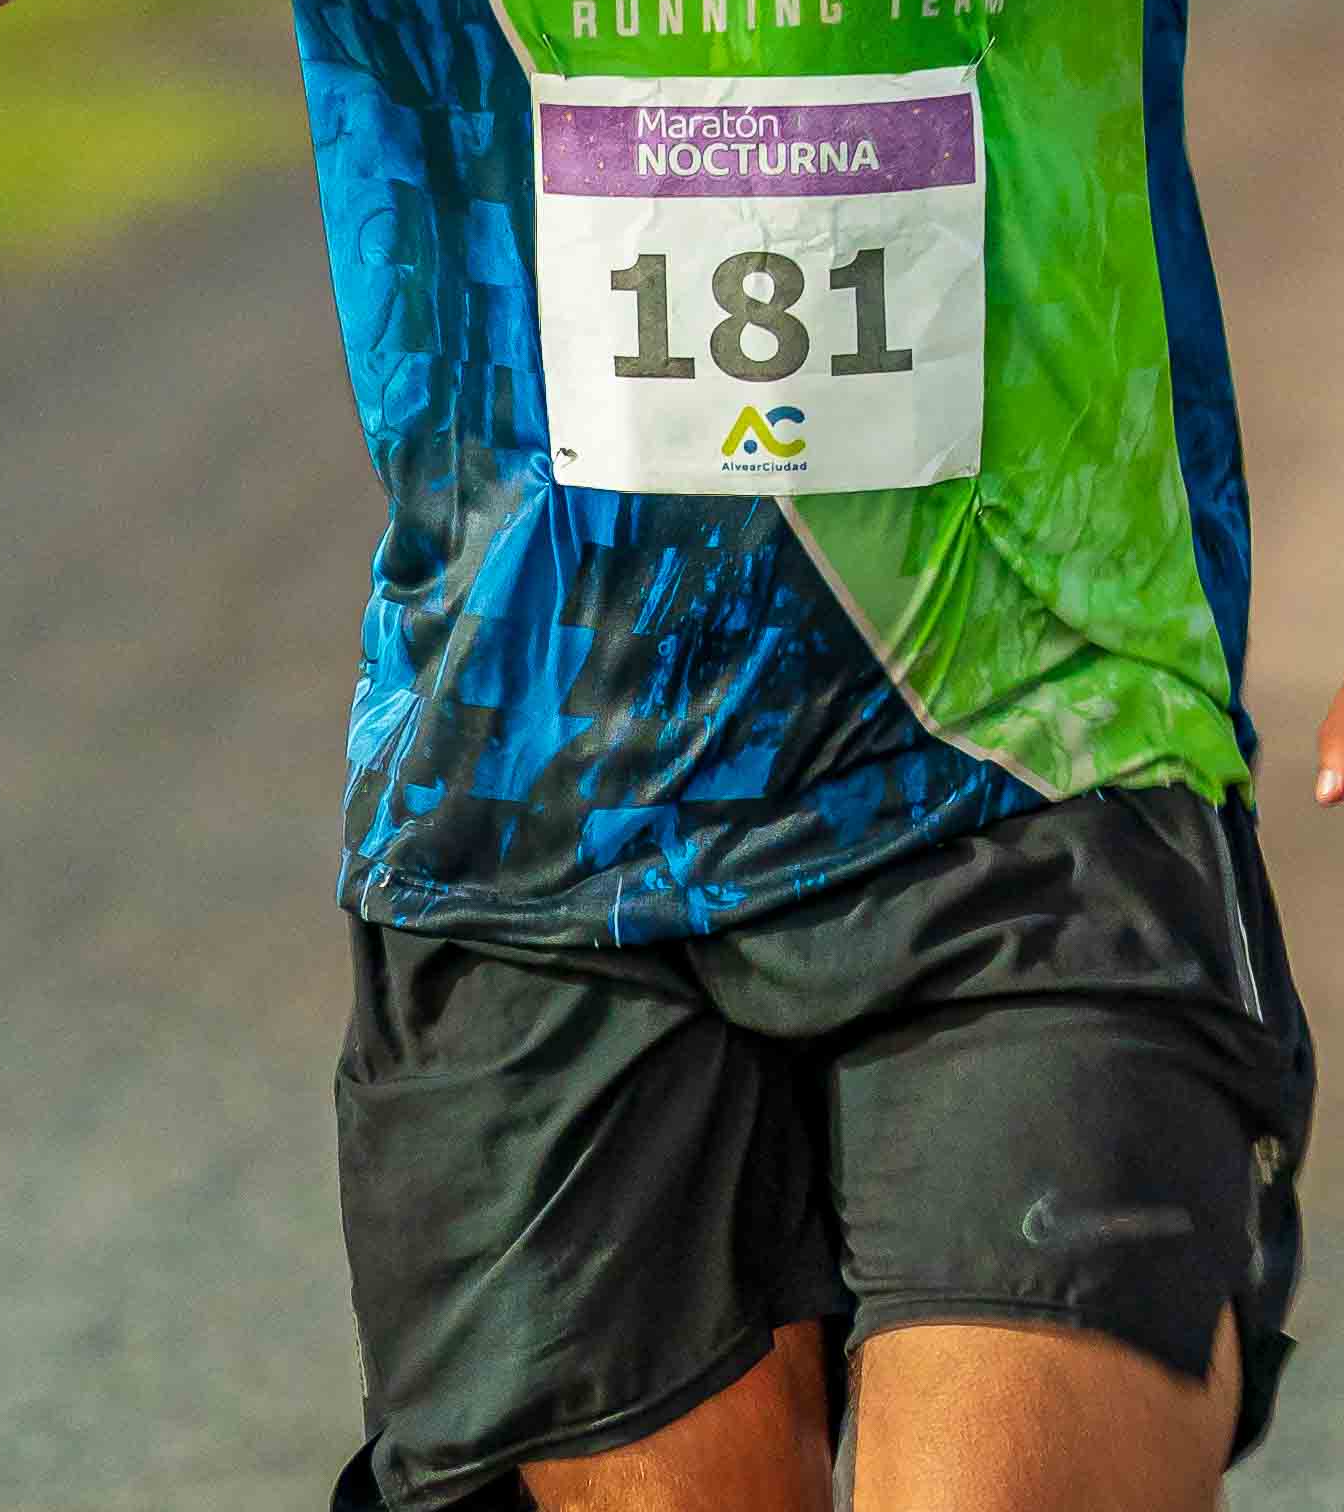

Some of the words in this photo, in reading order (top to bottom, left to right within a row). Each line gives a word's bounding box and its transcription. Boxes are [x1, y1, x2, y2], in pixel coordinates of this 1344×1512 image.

[637, 106, 778, 138] Maratón
[636, 140, 881, 175] NOCTURNA
[610, 247, 913, 382] 181
[721, 461, 808, 472] AlvearCiudad
